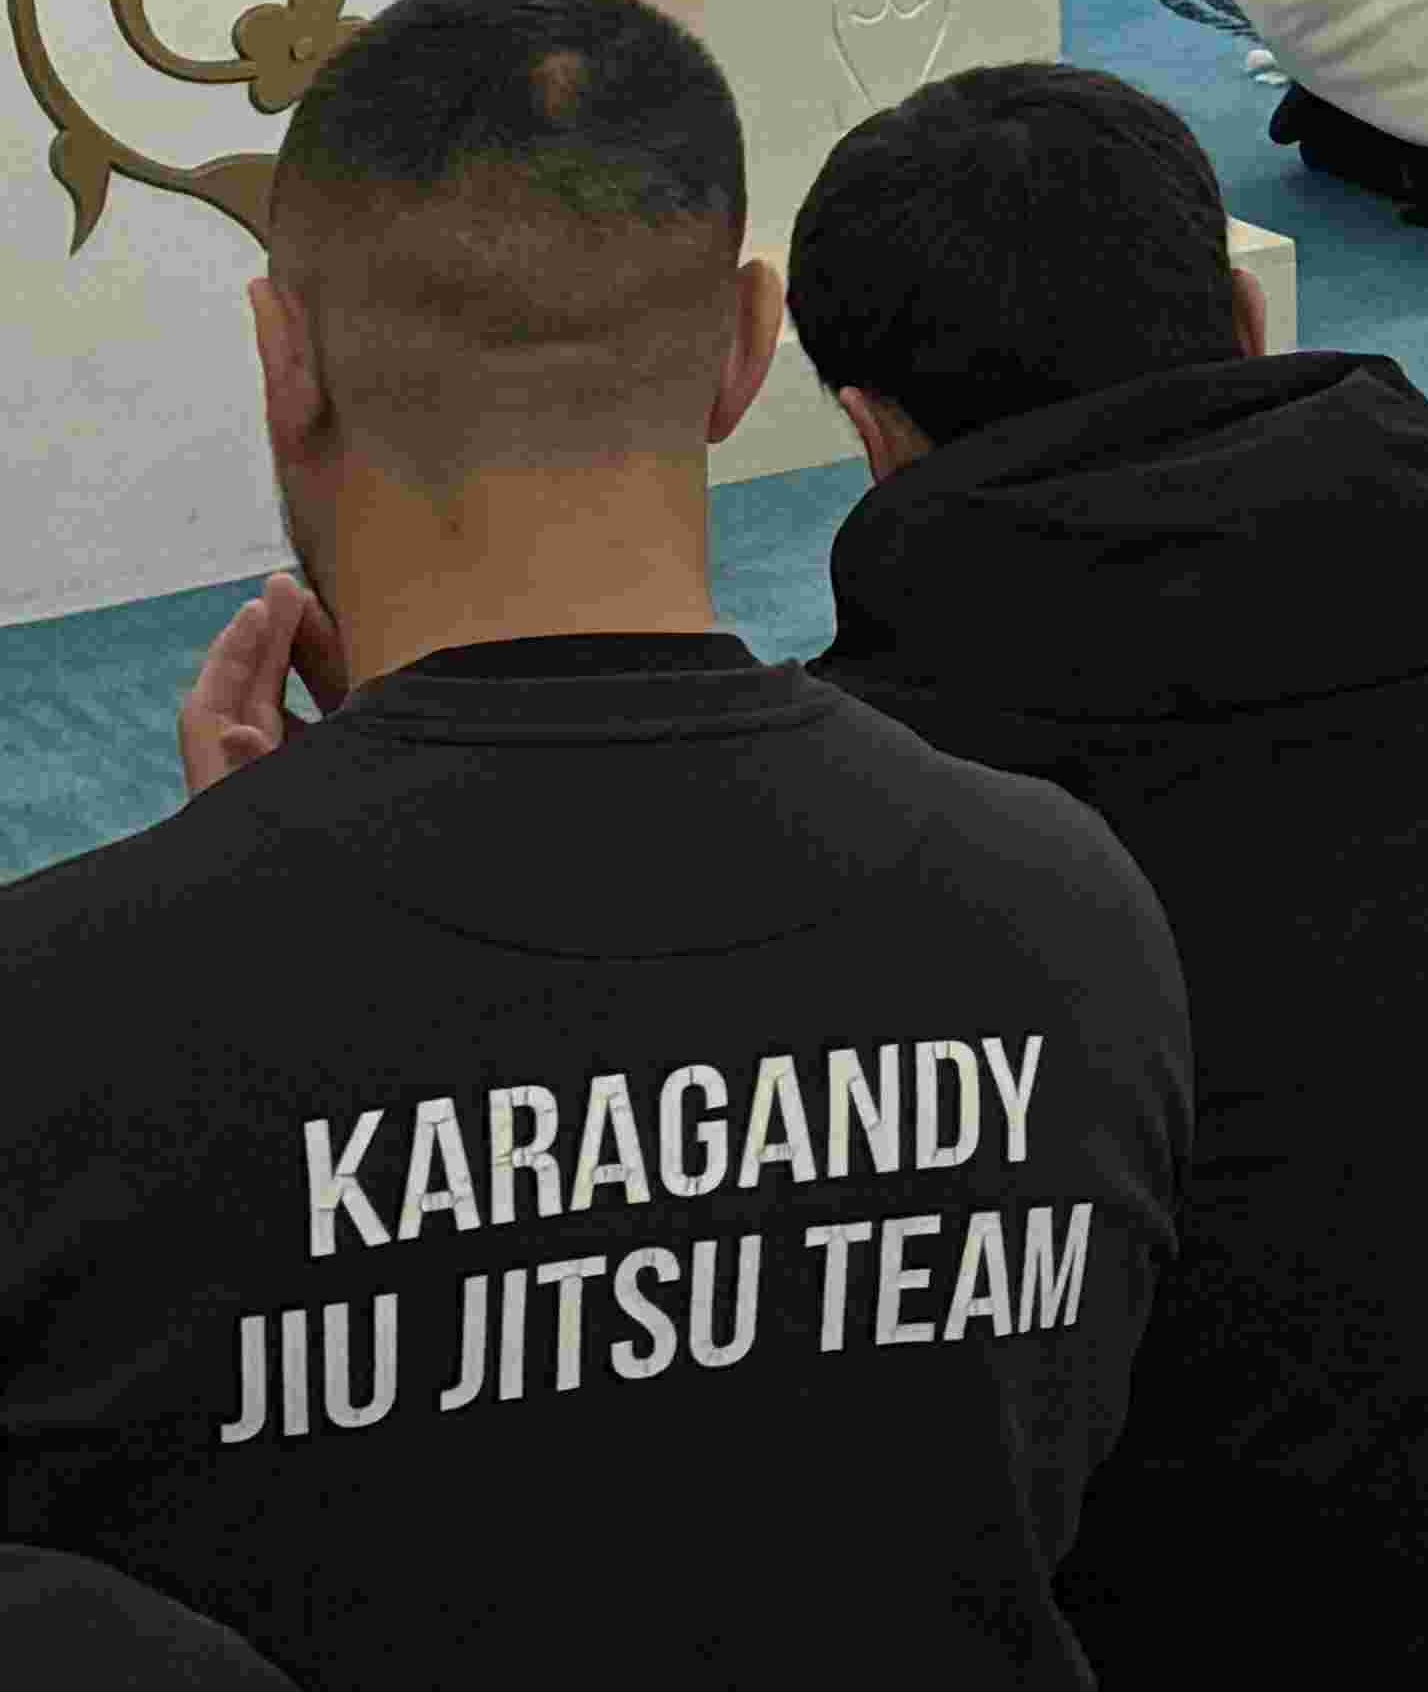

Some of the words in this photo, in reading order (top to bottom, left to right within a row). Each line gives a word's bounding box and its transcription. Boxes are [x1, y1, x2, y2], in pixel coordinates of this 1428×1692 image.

[303, 1035, 1044, 1257] KARAGANDY
[221, 1293, 398, 1443] JIU
[439, 1234, 762, 1412] JITSU
[804, 1202, 1093, 1353] TEAM
